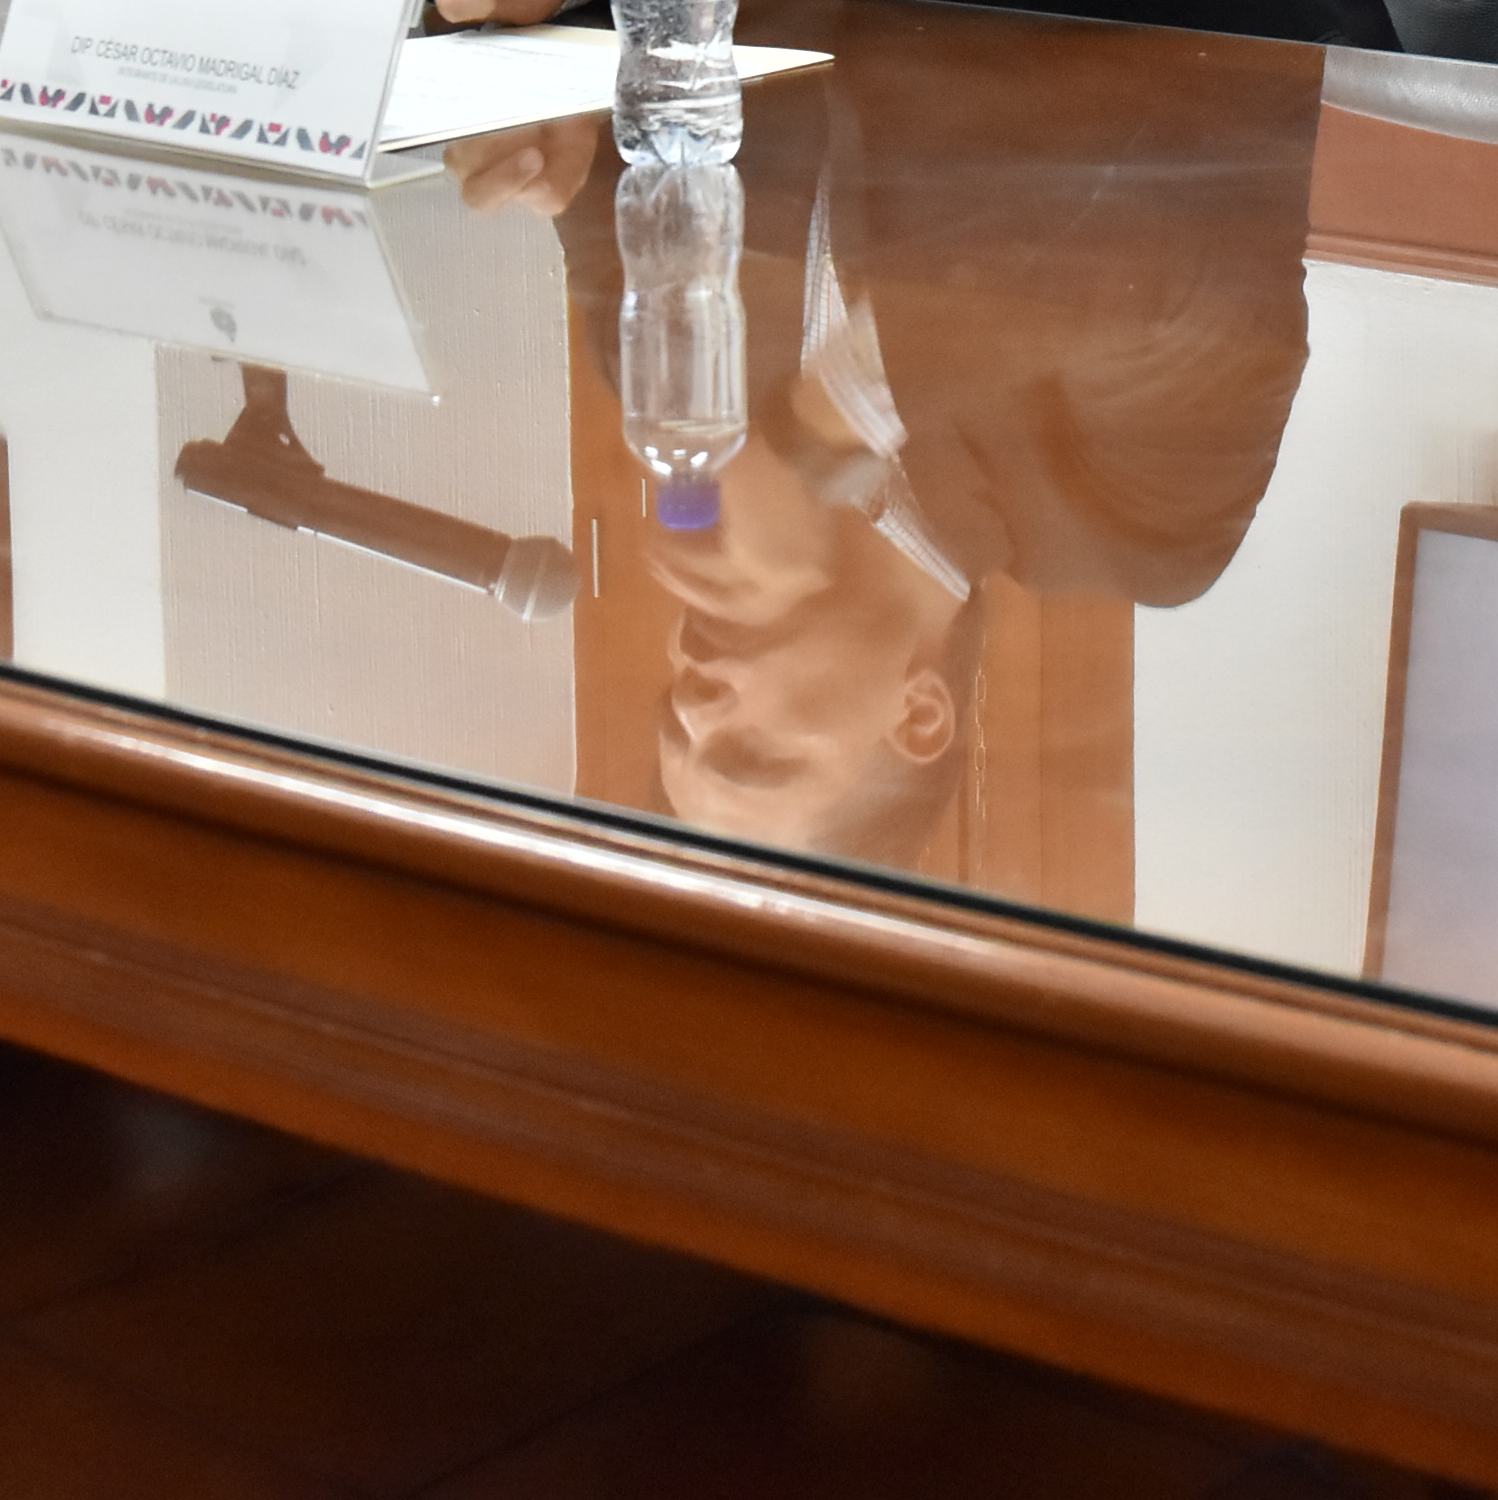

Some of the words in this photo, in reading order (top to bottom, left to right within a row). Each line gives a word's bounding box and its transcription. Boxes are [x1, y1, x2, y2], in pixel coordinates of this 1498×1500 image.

[95, 37, 138, 62] CÉSAR
[140, 46, 197, 73] OCTAVIO
[197, 56, 264, 84] MADRIGAL
